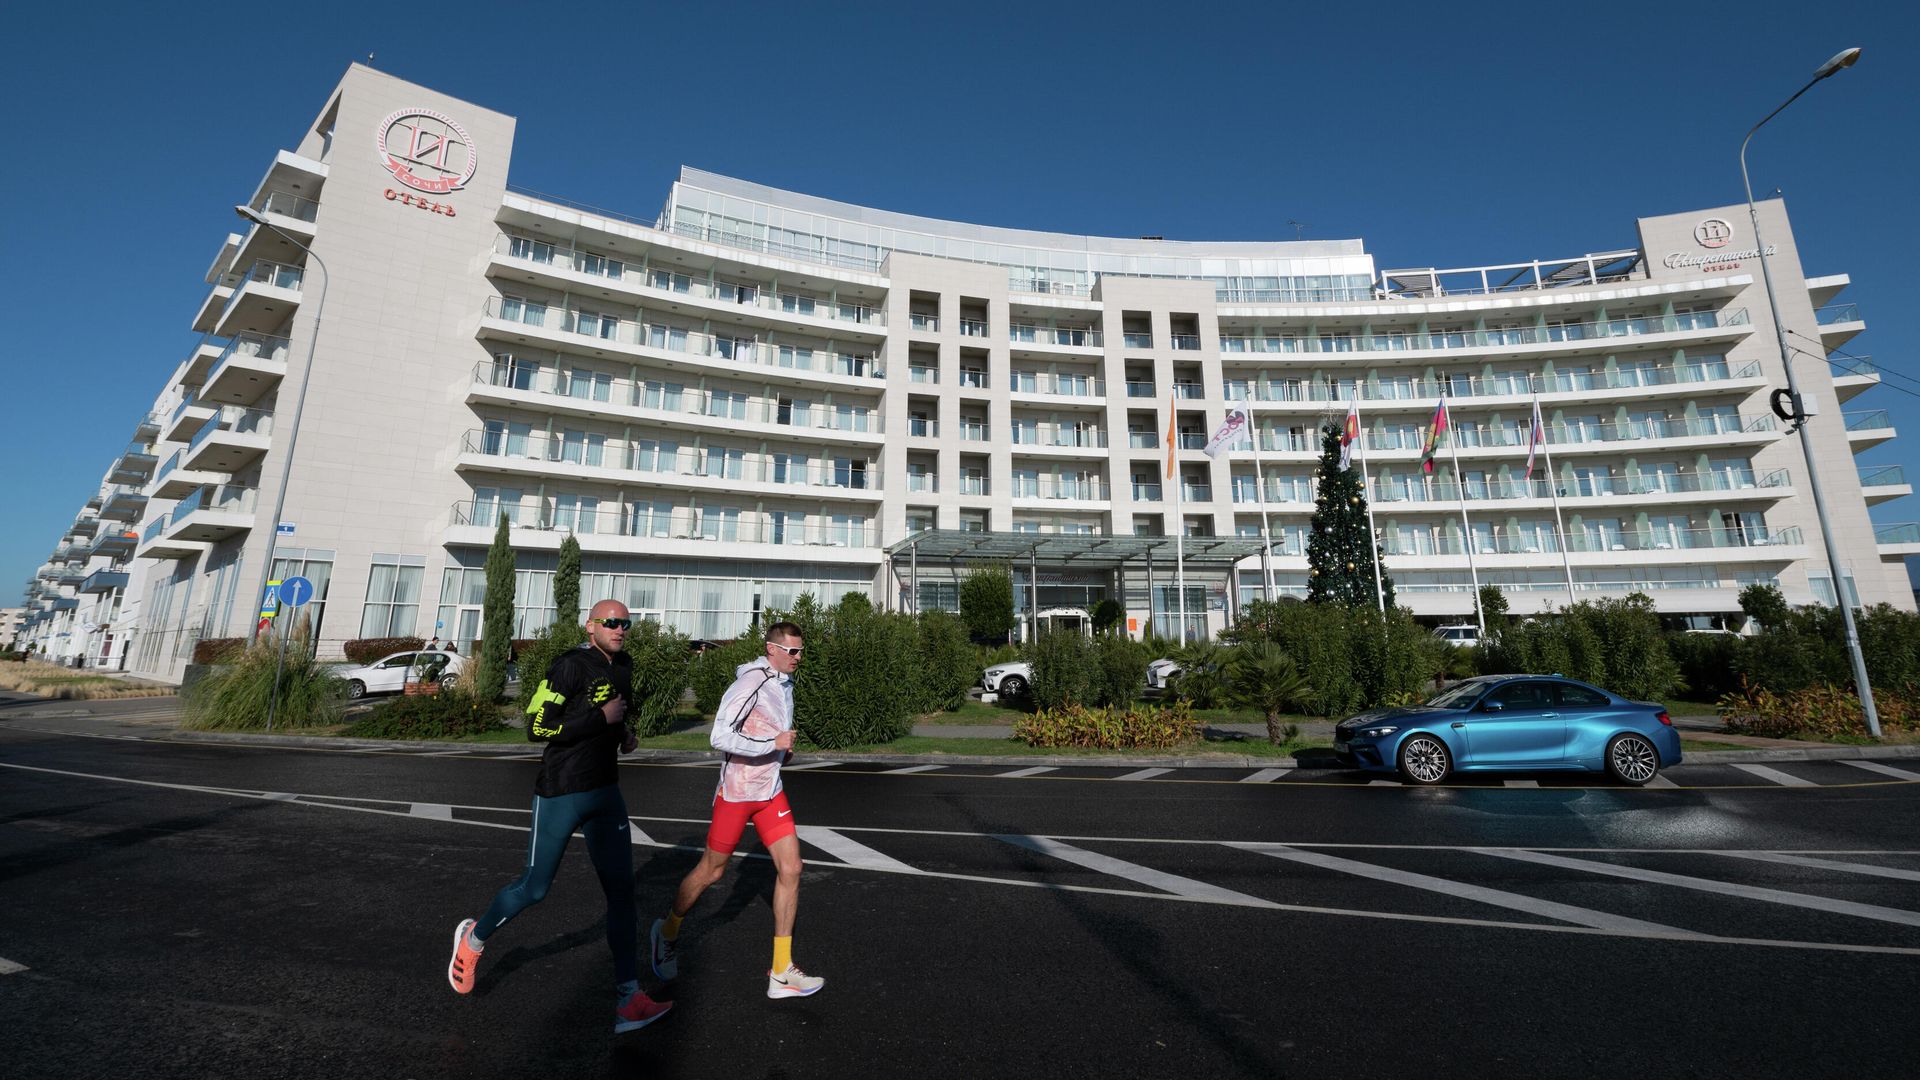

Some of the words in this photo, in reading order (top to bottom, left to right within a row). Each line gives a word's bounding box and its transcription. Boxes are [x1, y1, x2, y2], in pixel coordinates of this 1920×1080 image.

[402, 174, 442, 190] СОЧИ
[384, 188, 456, 217] ОТЕЛЬ
[1663, 244, 1777, 269] Имеретинскй
